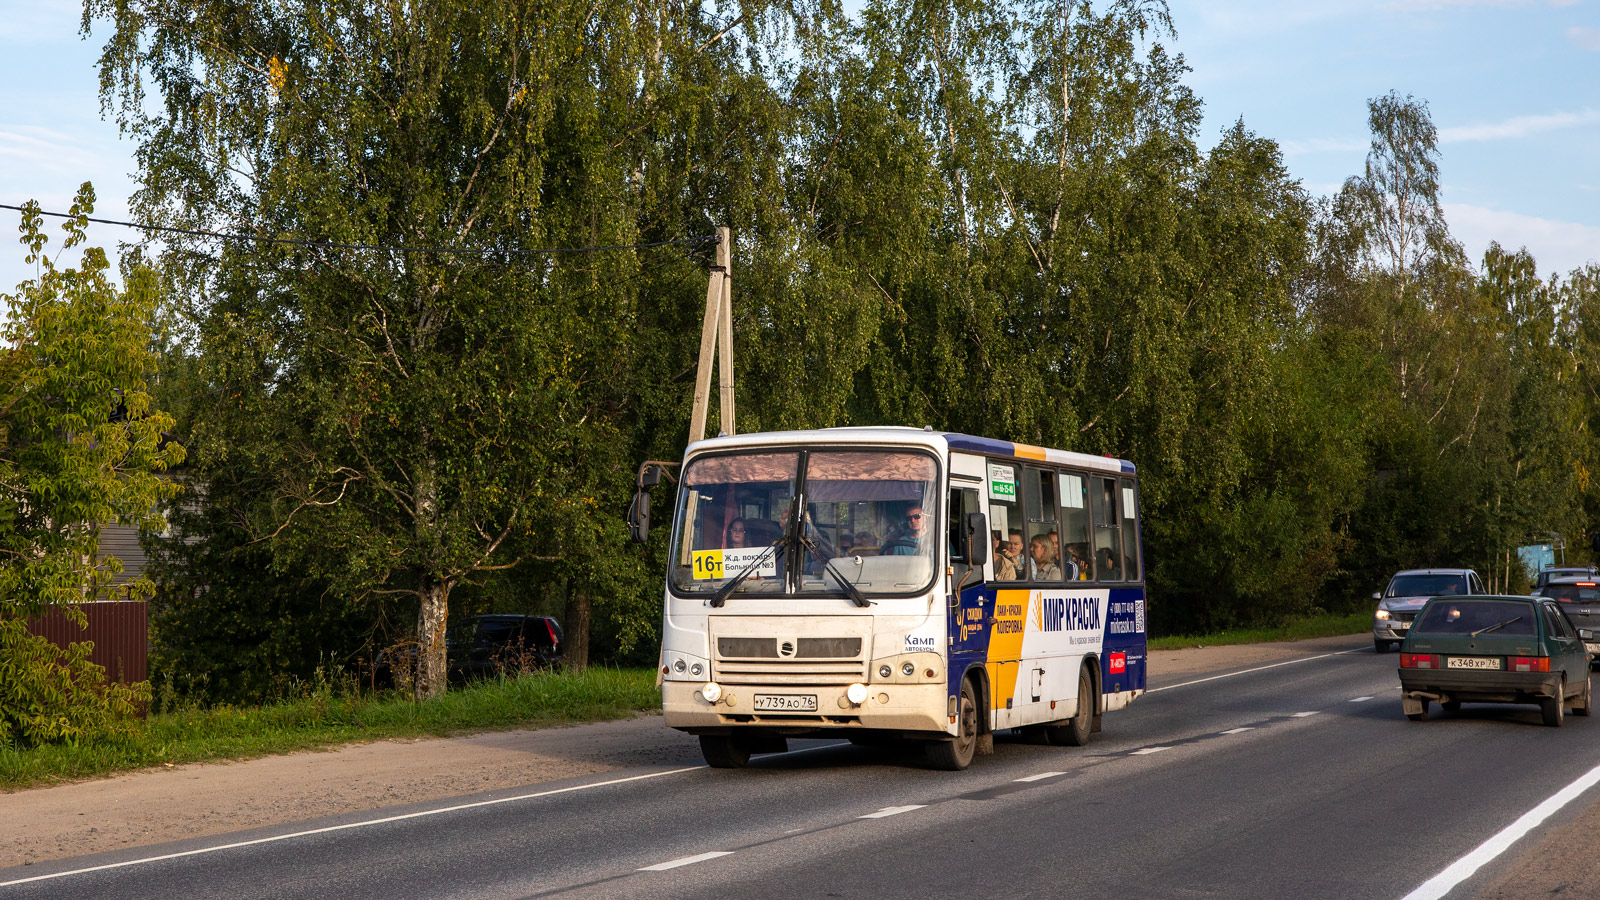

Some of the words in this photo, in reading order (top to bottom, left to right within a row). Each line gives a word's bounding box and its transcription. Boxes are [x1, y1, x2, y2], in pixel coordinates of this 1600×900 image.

[695, 555, 723, 573] 16т
[724, 554, 741, 562] Ж.д.
[1043, 598, 1064, 632] МИР
[1065, 597, 1101, 631] КРАСОК
[996, 619, 1024, 634] КОЛЕРОВКА
[904, 634, 935, 645] Камп
[759, 696, 800, 709] У739АО
[801, 697, 813, 706] 76
